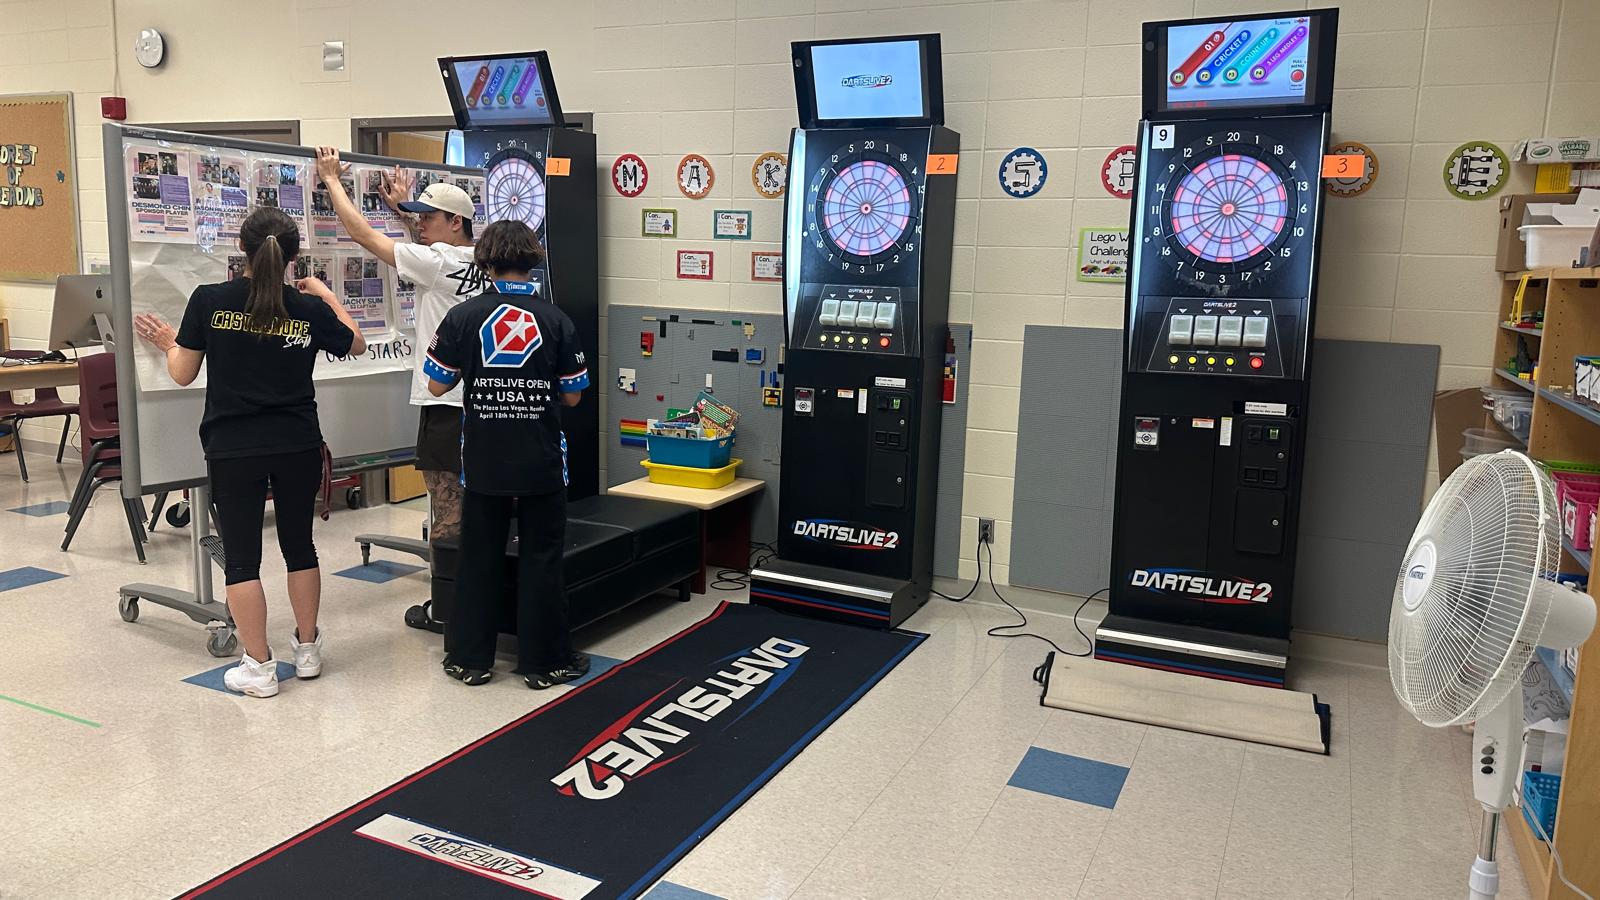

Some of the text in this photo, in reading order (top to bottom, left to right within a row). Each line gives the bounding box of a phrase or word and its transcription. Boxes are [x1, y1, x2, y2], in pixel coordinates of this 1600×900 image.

[1204, 40, 1214, 51] 01
[1280, 35, 1298, 54] MEDLEY
[1214, 39, 1243, 67] CRICKET
[842, 75, 893, 88] DARTSLIVE2
[1160, 130, 1168, 142] 9
[1206, 136, 1213, 145] 5
[1227, 132, 1240, 142] 20
[1255, 136, 1259, 144] 1
[848, 144, 854, 153] 5
[864, 141, 874, 149] 20
[886, 144, 889, 153] 1
[1183, 148, 1192, 157] 12
[1274, 145, 1284, 155] 18
[0, 144, 38, 166] OREST
[484, 152, 490, 160] 12
[832, 155, 838, 163] 12
[900, 154, 907, 162] 18
[936, 158, 946, 170] 2
[1168, 164, 1175, 173] 9
[1289, 161, 1296, 170] 4
[1337, 158, 1348, 174] 3
[622, 163, 781, 188] M A K
[1012, 162, 1036, 188] S
[1457, 155, 1493, 188] E
[7, 166, 23, 187] OF
[1156, 183, 1165, 192] 14
[1297, 181, 1308, 190] 13
[0, 186, 44, 208] EADING
[132, 202, 171, 210] DESMOND
[1152, 206, 1159, 214] 11
[1300, 204, 1307, 213] 6
[810, 222, 815, 230] 8
[1153, 227, 1160, 236] 8
[1293, 227, 1304, 236] 10
[1090, 232, 1116, 244] Lego
[1161, 247, 1171, 256] 16
[1280, 247, 1291, 257] 15
[893, 255, 899, 263] 2
[860, 266, 865, 274] 3
[1177, 262, 1184, 270] 7
[1264, 262, 1271, 271] 2
[1195, 271, 1204, 280] 19
[1219, 274, 1225, 283] 3
[1241, 272, 1252, 281] 17
[211, 310, 310, 338] CASTMORE
[368, 338, 412, 360] STARS
[473, 378, 550, 389] ARTSLIVE OPEN
[496, 391, 525, 402] USA
[794, 520, 899, 548] DARTSLIVE2
[1131, 570, 1272, 603] DARTSLIVE2
[550, 636, 810, 800] DARTSLIVE2
[408, 833, 544, 880] DARTSLIVE2
